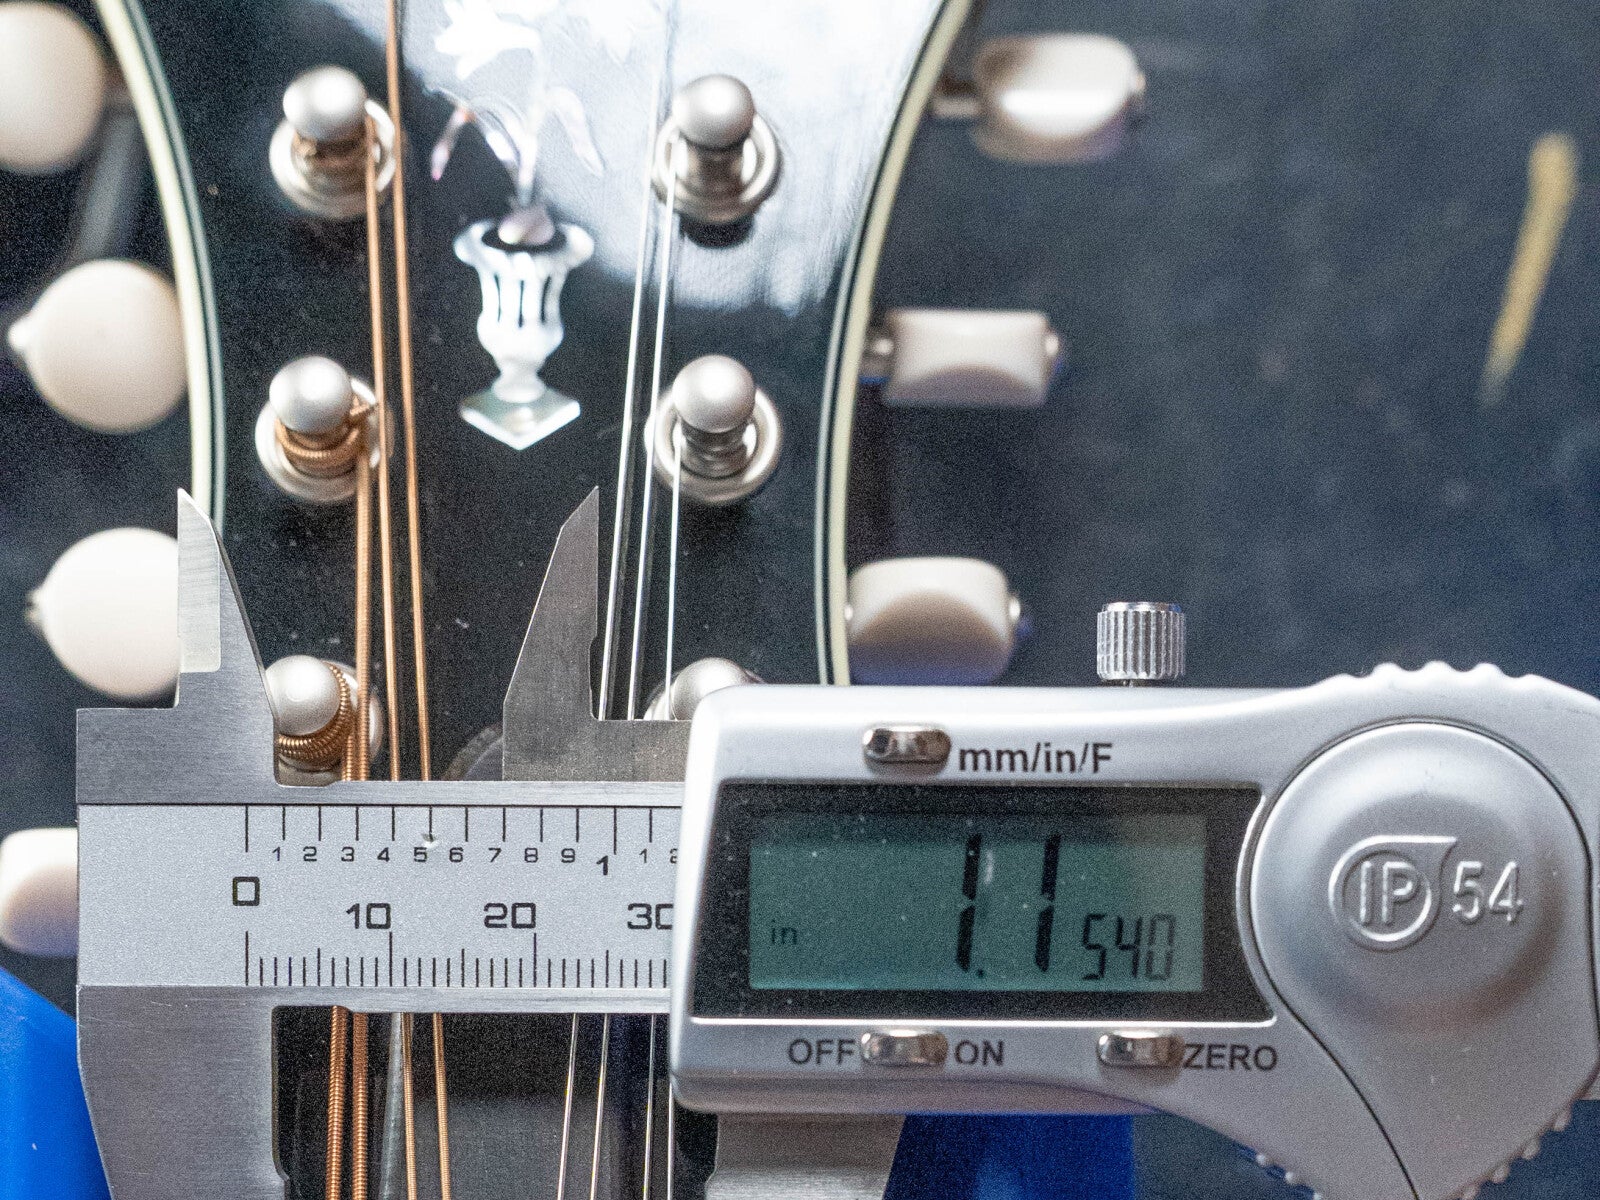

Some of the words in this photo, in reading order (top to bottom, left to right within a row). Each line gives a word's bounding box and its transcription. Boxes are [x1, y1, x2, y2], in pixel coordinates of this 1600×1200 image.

[958, 743, 1113, 774] mm/in/F
[273, 847, 281, 862] 1
[302, 846, 318, 862] 2
[340, 847, 355, 863] 3
[377, 847, 391, 862] 4
[413, 847, 428, 863] 5
[449, 847, 464, 863] 6
[488, 847, 502, 863] 7
[523, 847, 539, 864] 8
[561, 848, 576, 864] 9
[596, 855, 609, 876] 1
[639, 848, 649, 864] 1
[1359, 861, 1419, 924] IP
[1452, 861, 1524, 924] 54
[346, 903, 391, 930] 10
[483, 903, 537, 930] 20
[627, 903, 674, 931] 30
[770, 919, 798, 945] in
[788, 1039, 856, 1066] OFF
[955, 1041, 1005, 1067] ON
[1182, 1044, 1279, 1071] ZERO
